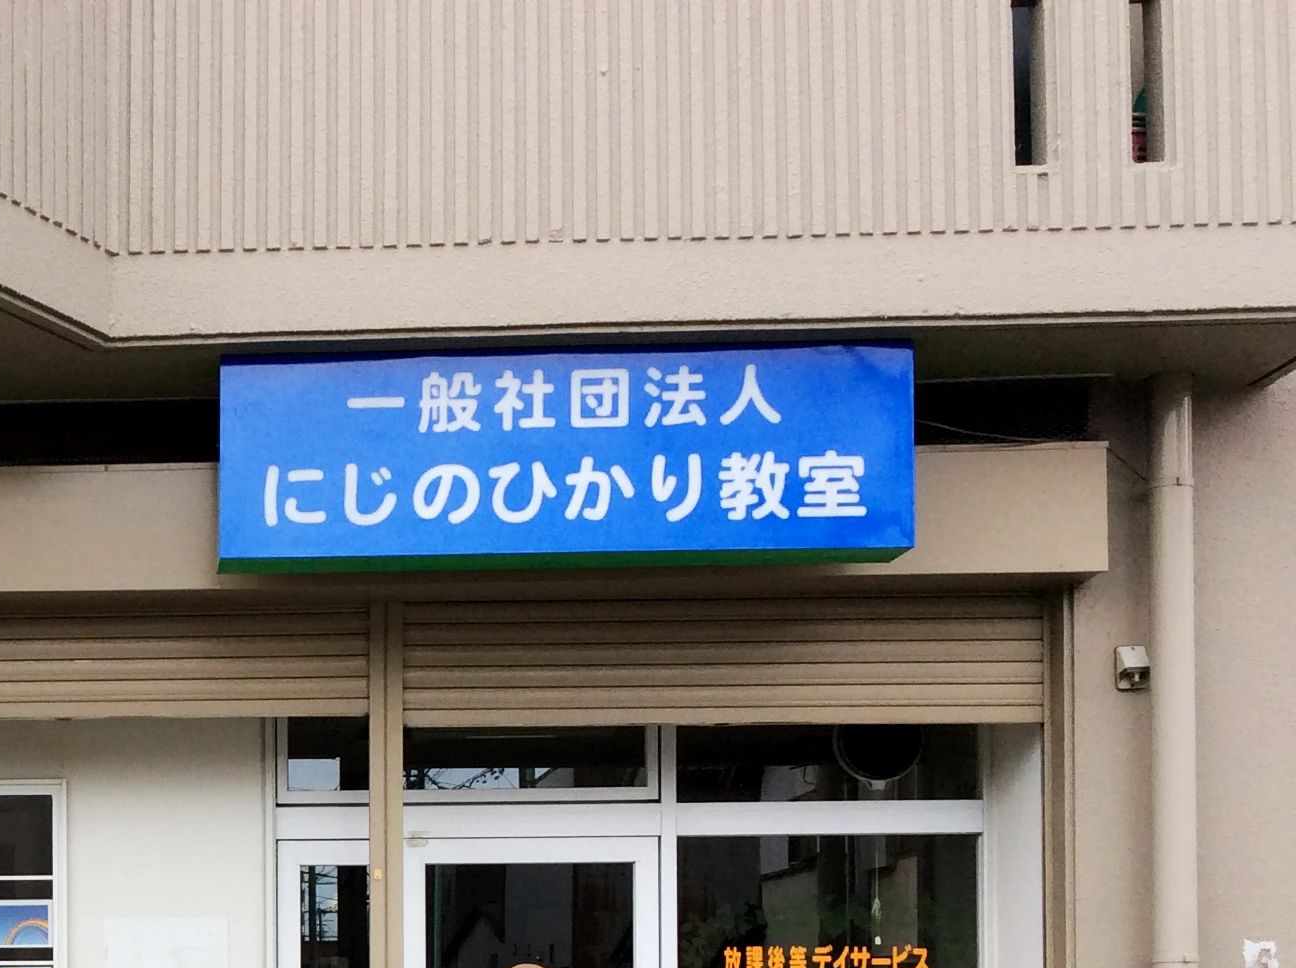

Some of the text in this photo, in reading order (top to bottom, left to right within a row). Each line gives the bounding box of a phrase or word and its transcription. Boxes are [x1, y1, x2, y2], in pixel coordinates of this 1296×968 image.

[347, 364, 782, 433] 一般社団法人
[264, 450, 867, 526] にじのひかり教室
